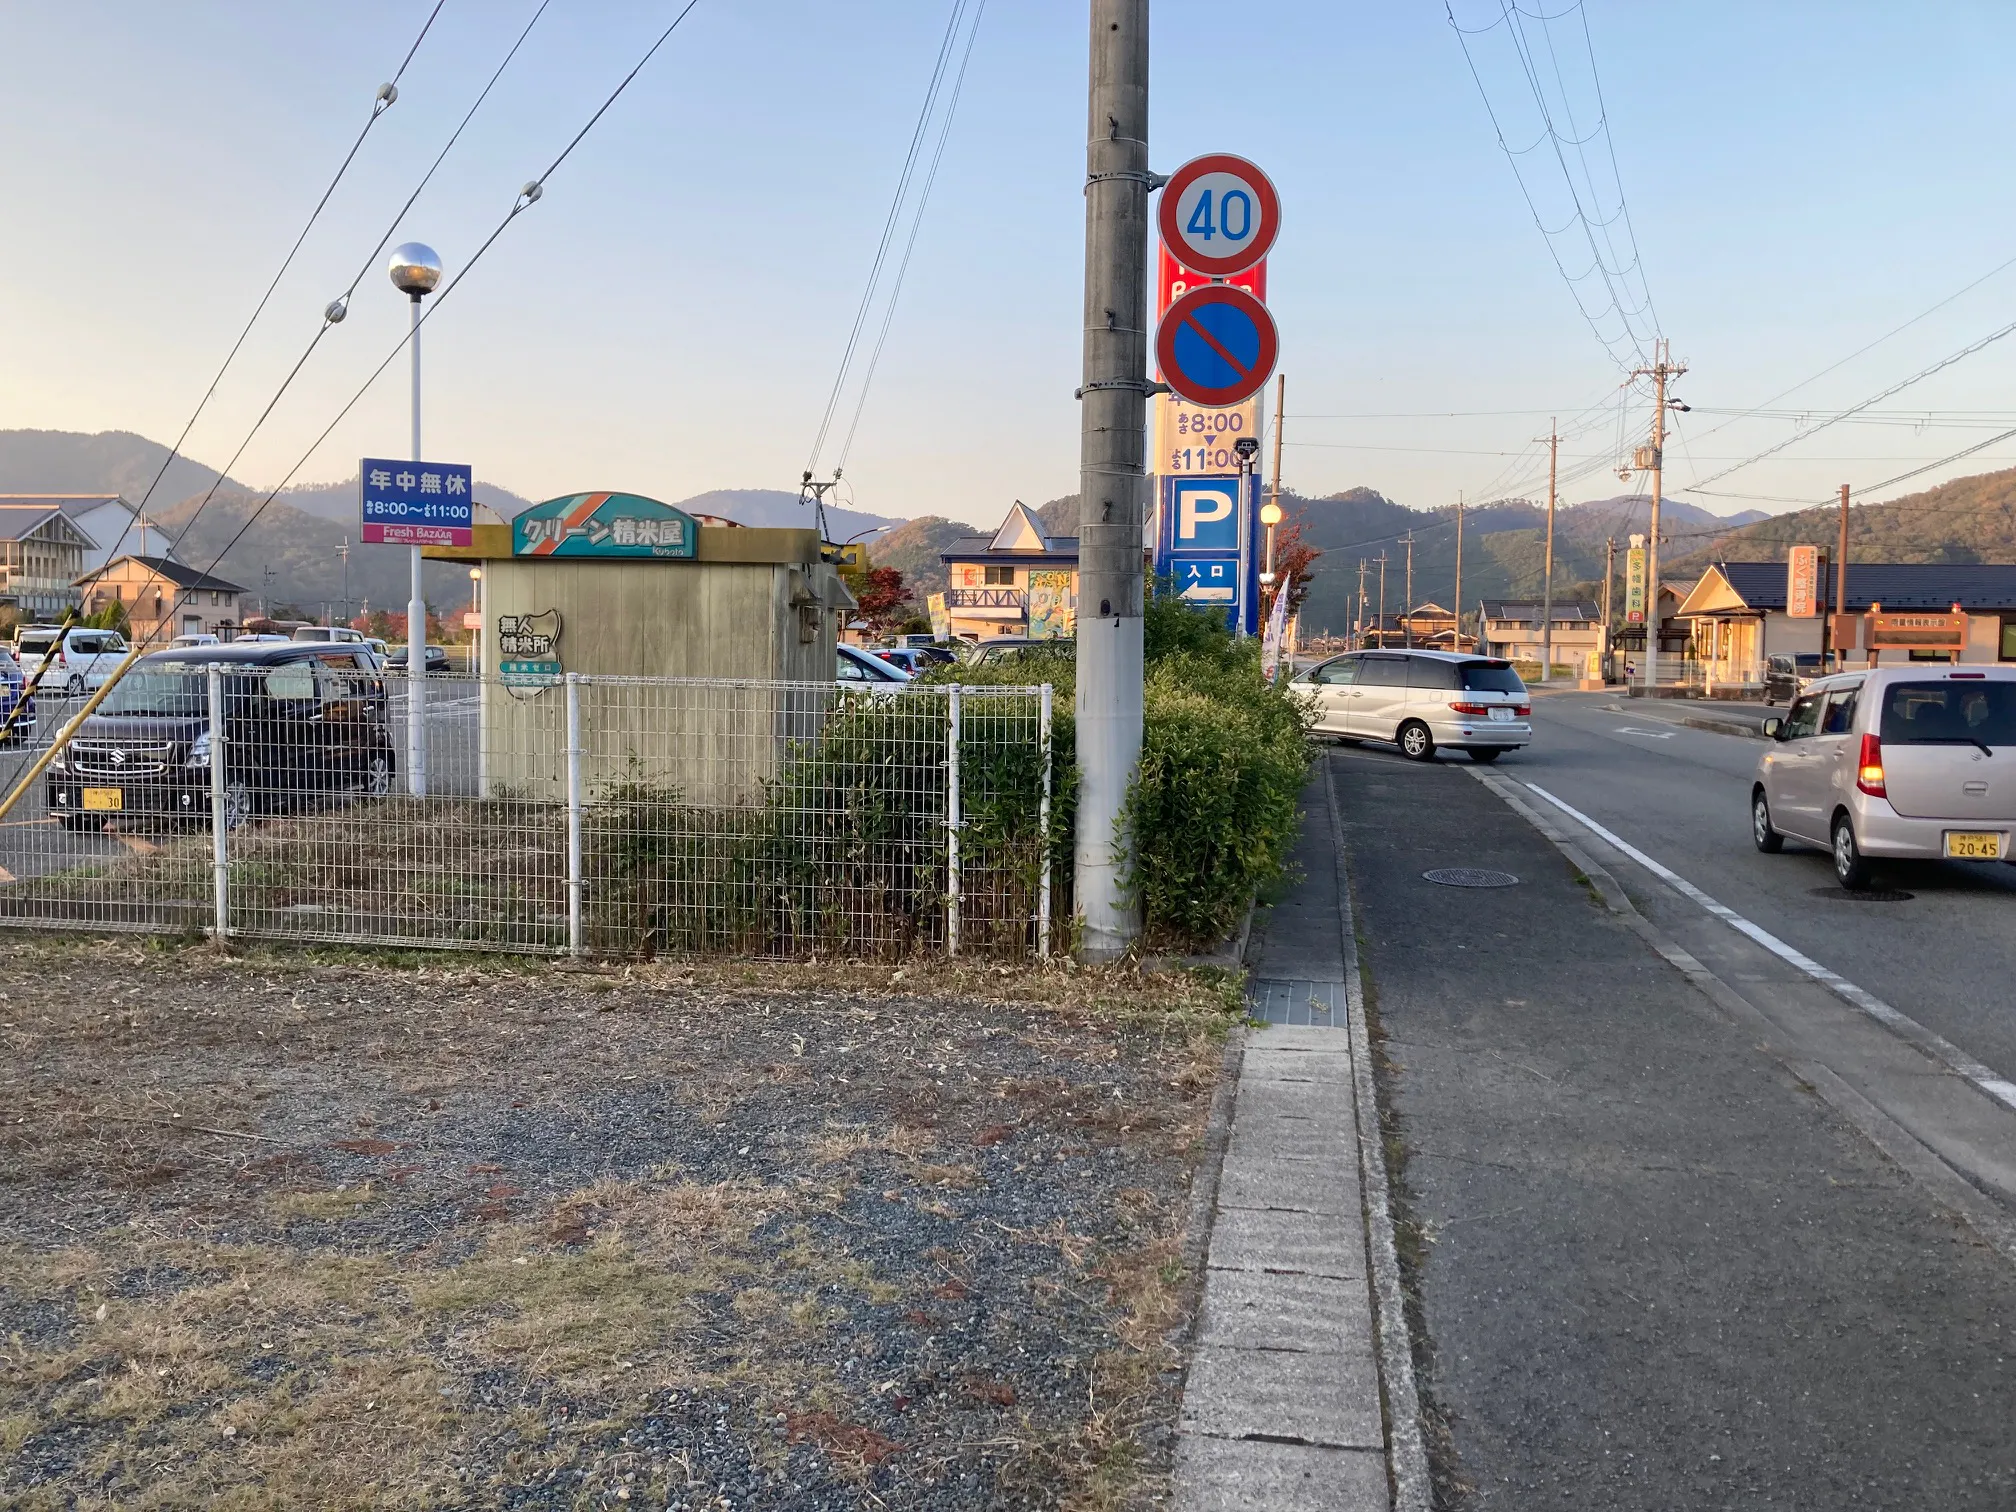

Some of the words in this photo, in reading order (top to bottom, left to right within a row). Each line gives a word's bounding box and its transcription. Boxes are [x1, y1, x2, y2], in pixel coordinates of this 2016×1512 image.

[1187, 189, 1251, 241] 40
[369, 468, 467, 495] 年中無休
[1180, 490, 1232, 539] P
[383, 526, 413, 538] Fresh
[522, 518, 683, 546] クリーン精米屋
[652, 548, 684, 556] Kubota
[1187, 564, 1223, 579] 入口
[500, 616, 533, 634] 無人
[501, 636, 550, 653] 精米所
[1959, 842, 1997, 856] 20-45
